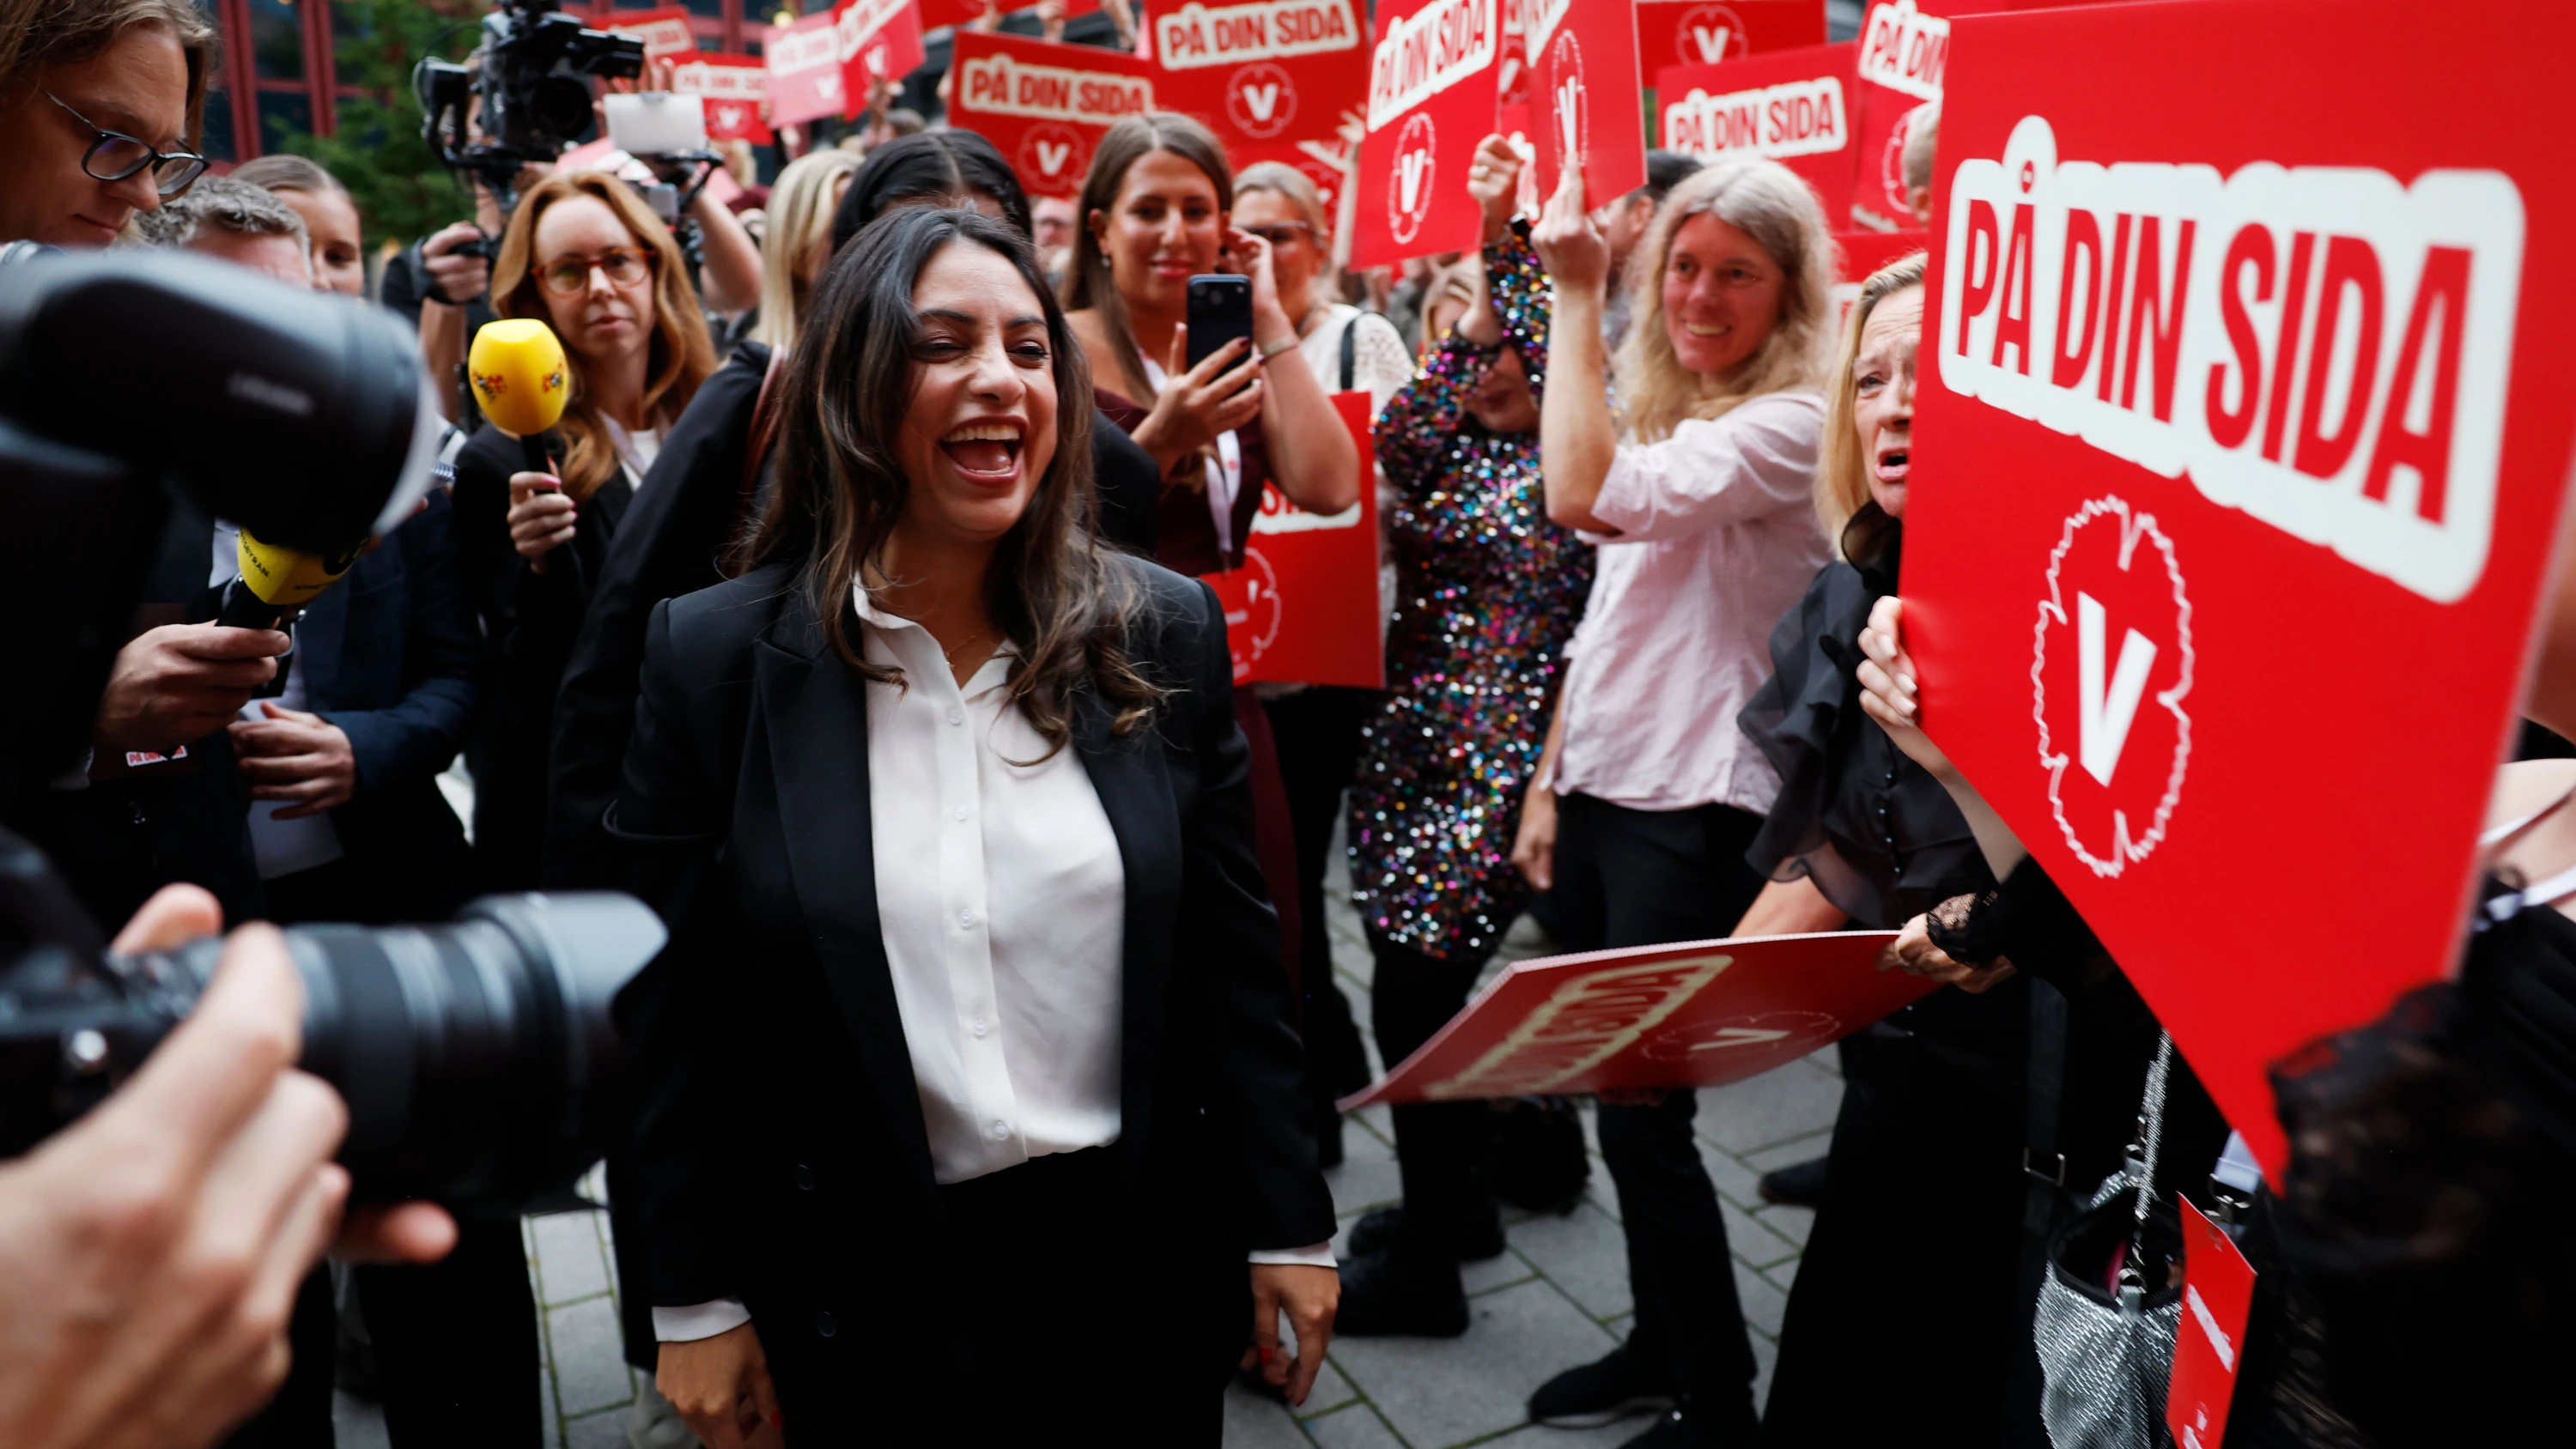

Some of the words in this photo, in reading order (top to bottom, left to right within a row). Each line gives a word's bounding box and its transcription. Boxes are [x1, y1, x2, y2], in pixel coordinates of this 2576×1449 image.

[1169, 13, 1206, 58] PÅ
[1215, 13, 1267, 53] DIN
[1276, 3, 1346, 45] SIDA
[1436, 0, 1485, 75] SIDA
[1692, 25, 1730, 65] V
[1868, 12, 1905, 75] PÅ
[971, 62, 1009, 104] PÅ
[1018, 74, 1071, 111] DIN
[1078, 81, 1145, 117] SIDA
[1242, 82, 1279, 122] V
[1675, 101, 1707, 157] PÅ
[1713, 103, 1759, 151] DIN
[1768, 92, 1835, 144] SIDA
[1036, 140, 1071, 175] V
[1400, 148, 1426, 213] V
[1959, 160, 2035, 377] PÅ
[2050, 208, 2197, 425] DIN
[2204, 221, 2474, 528] SIDA
[2078, 591, 2158, 787] V
